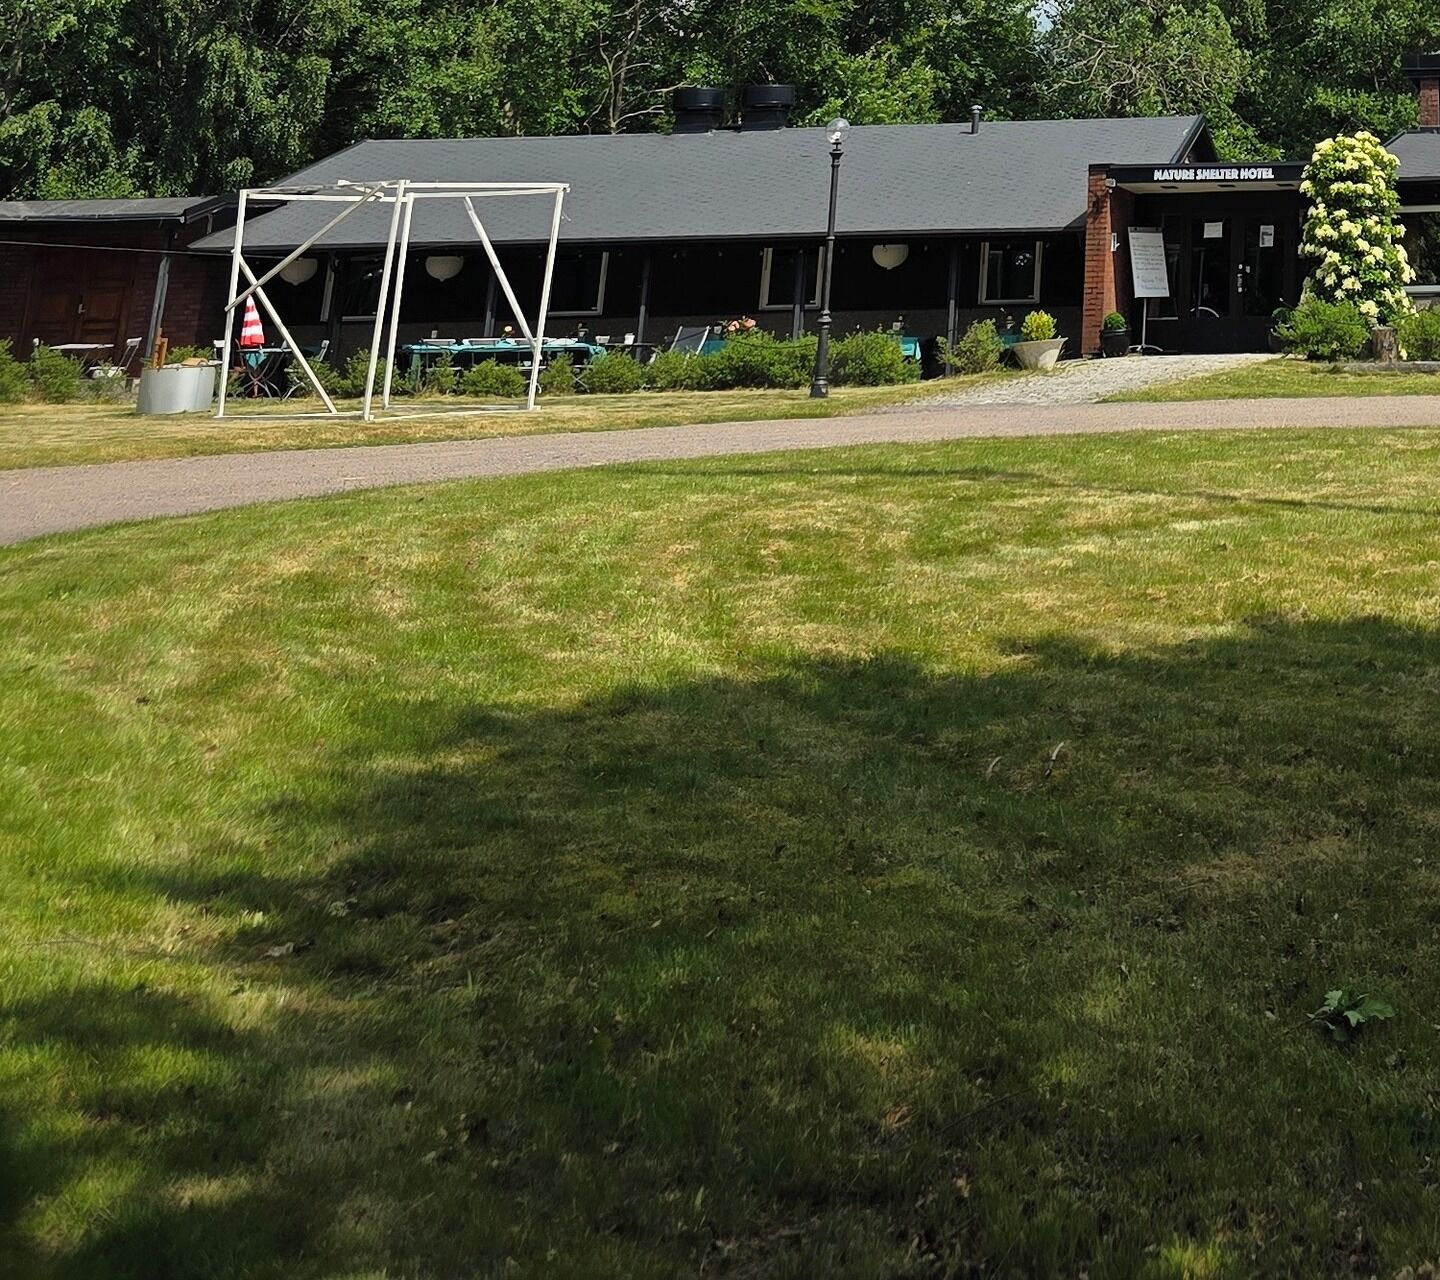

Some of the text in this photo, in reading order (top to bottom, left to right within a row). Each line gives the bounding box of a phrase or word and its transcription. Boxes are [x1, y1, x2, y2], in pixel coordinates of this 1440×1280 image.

[1153, 167, 1275, 180] NATURE SHELTER HOTEL
